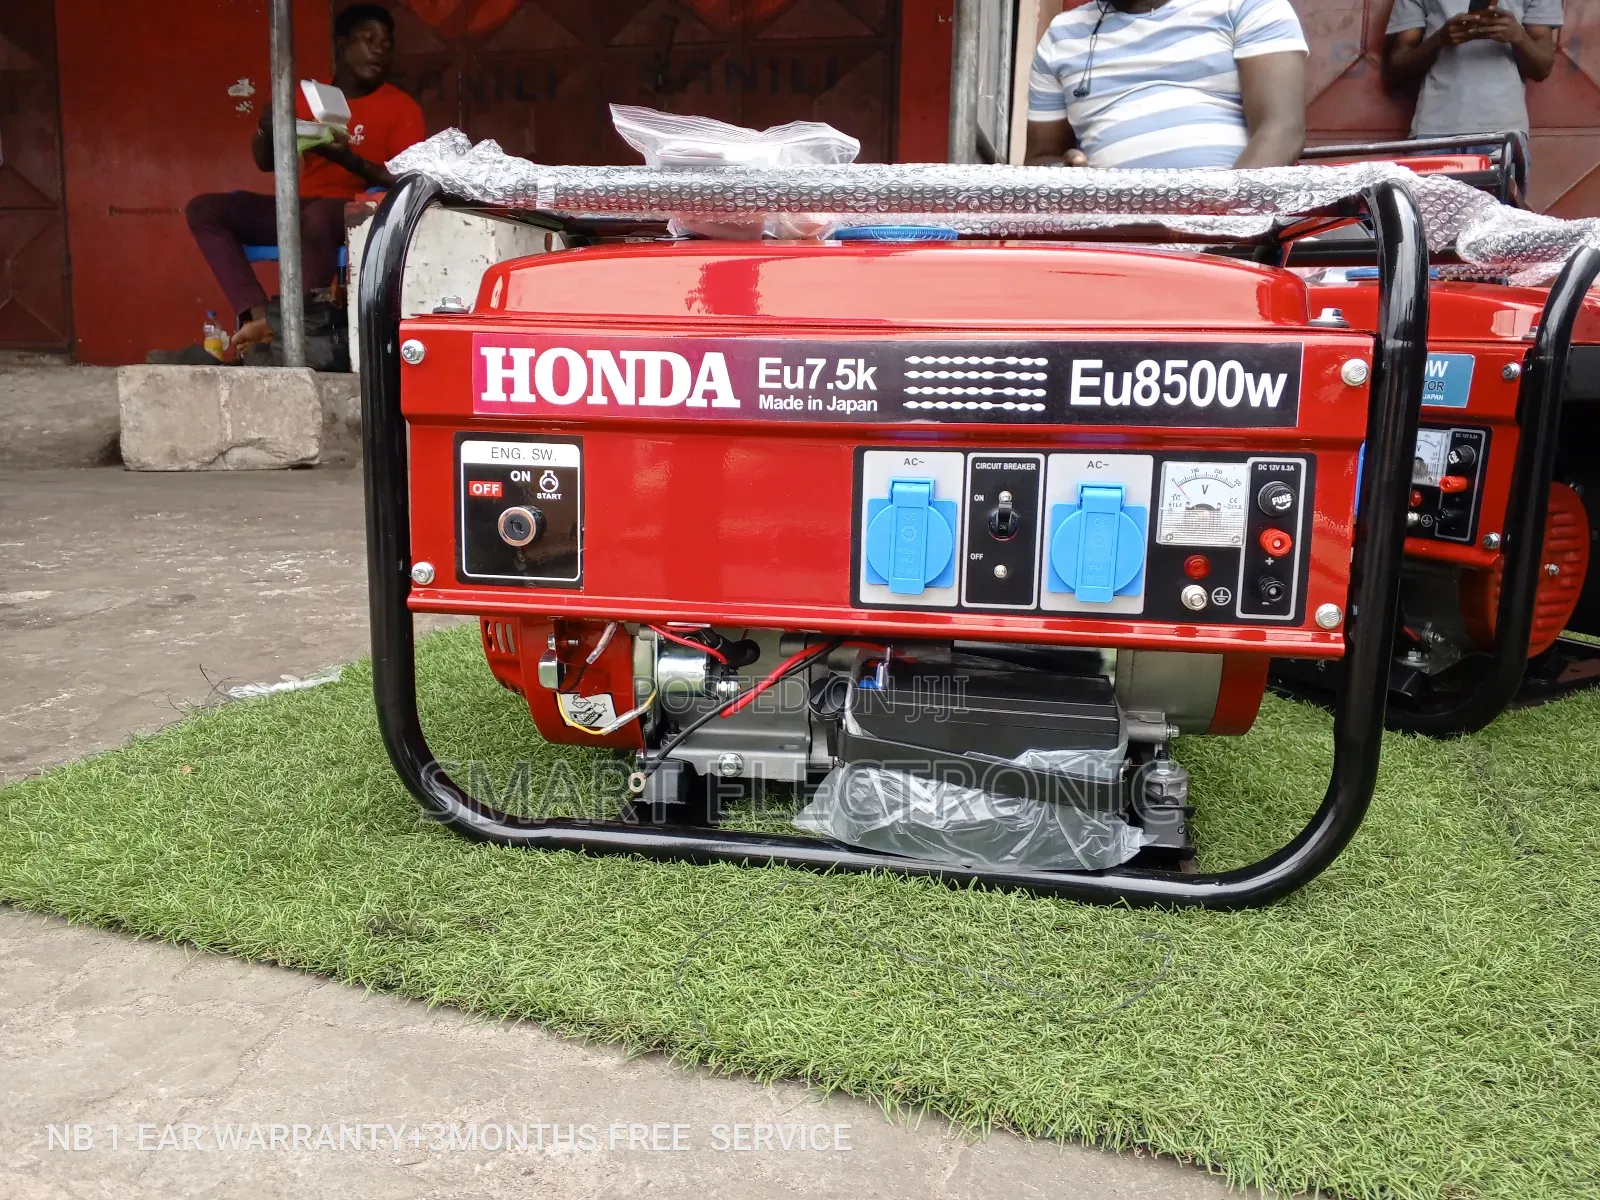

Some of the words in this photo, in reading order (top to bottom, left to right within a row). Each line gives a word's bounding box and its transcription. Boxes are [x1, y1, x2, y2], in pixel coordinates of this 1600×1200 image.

[1424, 360, 1449, 378] W
[480, 346, 741, 408] HONDA
[758, 356, 878, 391] Eu7.5k
[1069, 358, 1288, 408] Eu8500w
[1423, 380, 1445, 392] TOR
[758, 394, 804, 411] Made
[807, 396, 824, 411] in
[826, 396, 878, 413] Japan
[491, 446, 525, 460] ENG.
[531, 448, 557, 461] SW.
[975, 462, 1002, 470] CIRCUIT
[1003, 463, 1036, 471] BREAKER
[510, 470, 531, 482] ON
[472, 483, 500, 495] OFF
[1201, 484, 1209, 495] V
[536, 492, 562, 500] START
[974, 494, 985, 502] ON
[1271, 493, 1293, 506] FUSE
